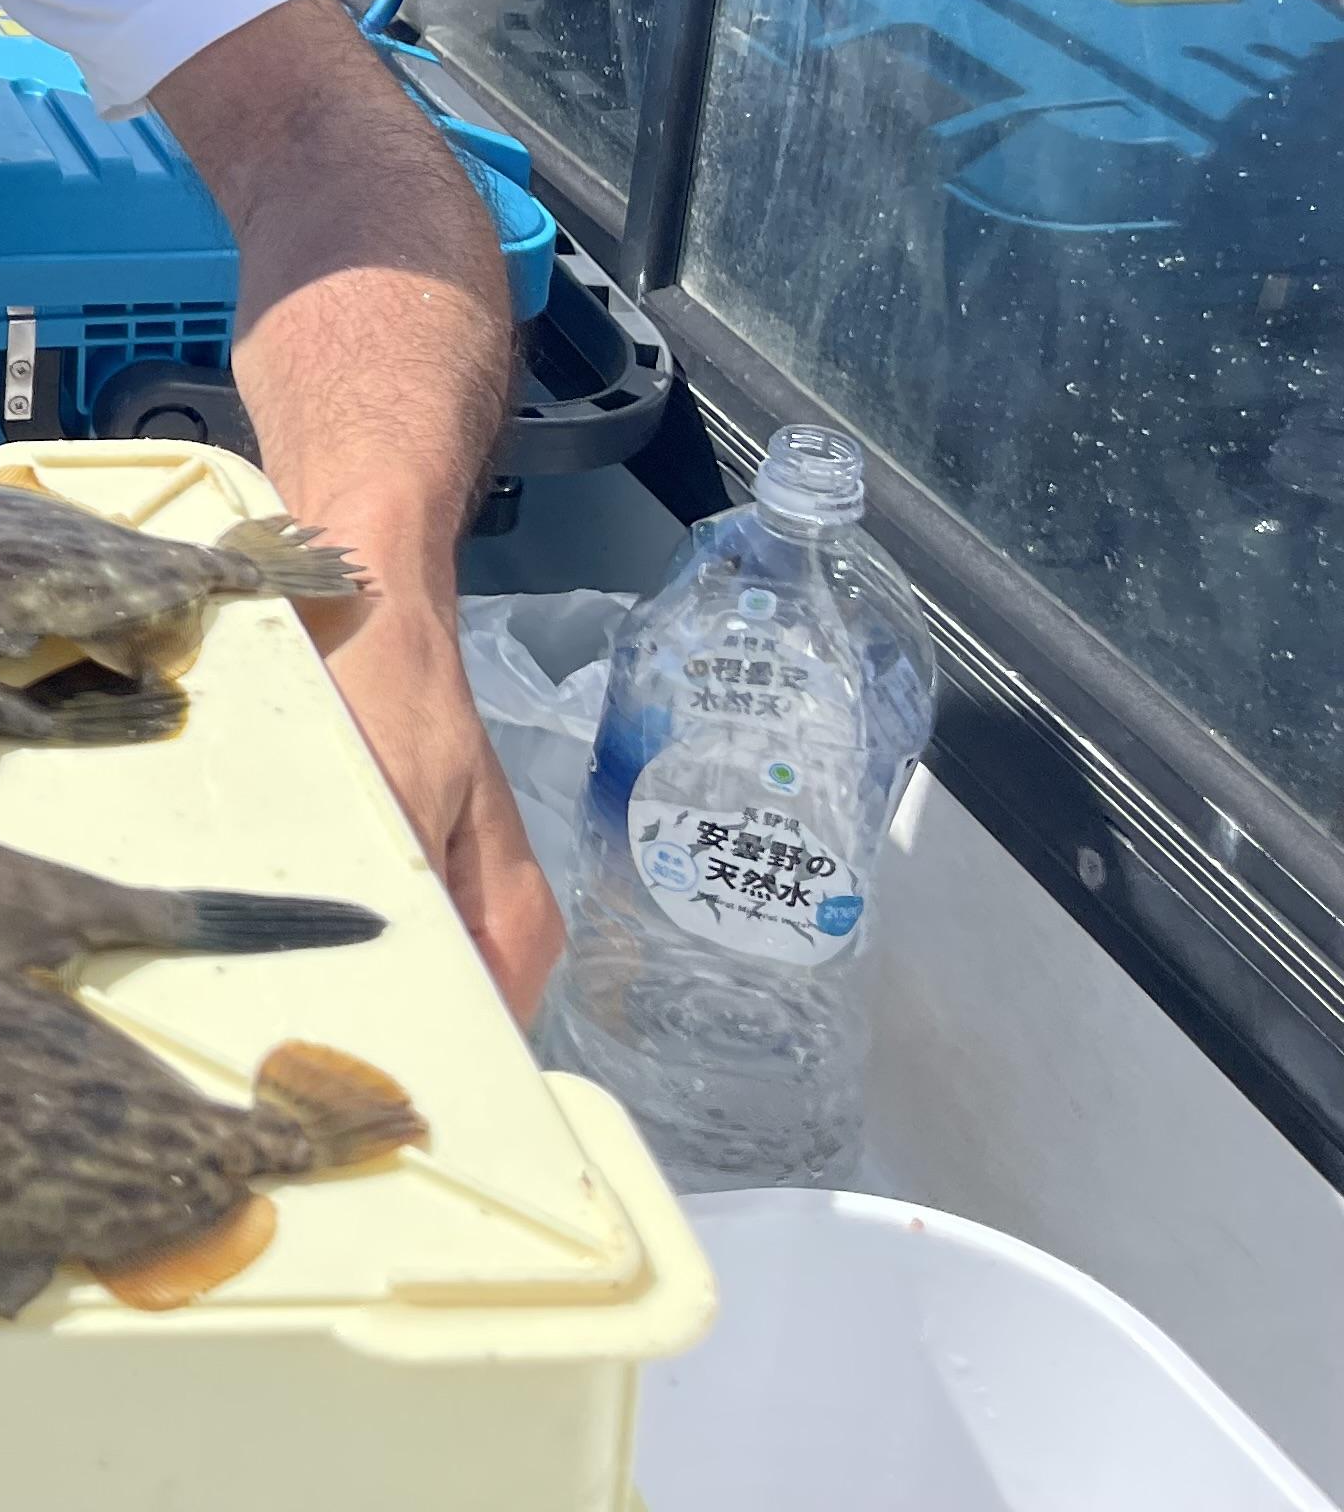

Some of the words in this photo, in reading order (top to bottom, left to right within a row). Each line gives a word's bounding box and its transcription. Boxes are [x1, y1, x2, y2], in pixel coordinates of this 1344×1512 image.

[697, 820, 836, 877] 安曇野の
[705, 856, 812, 907] 天然水
